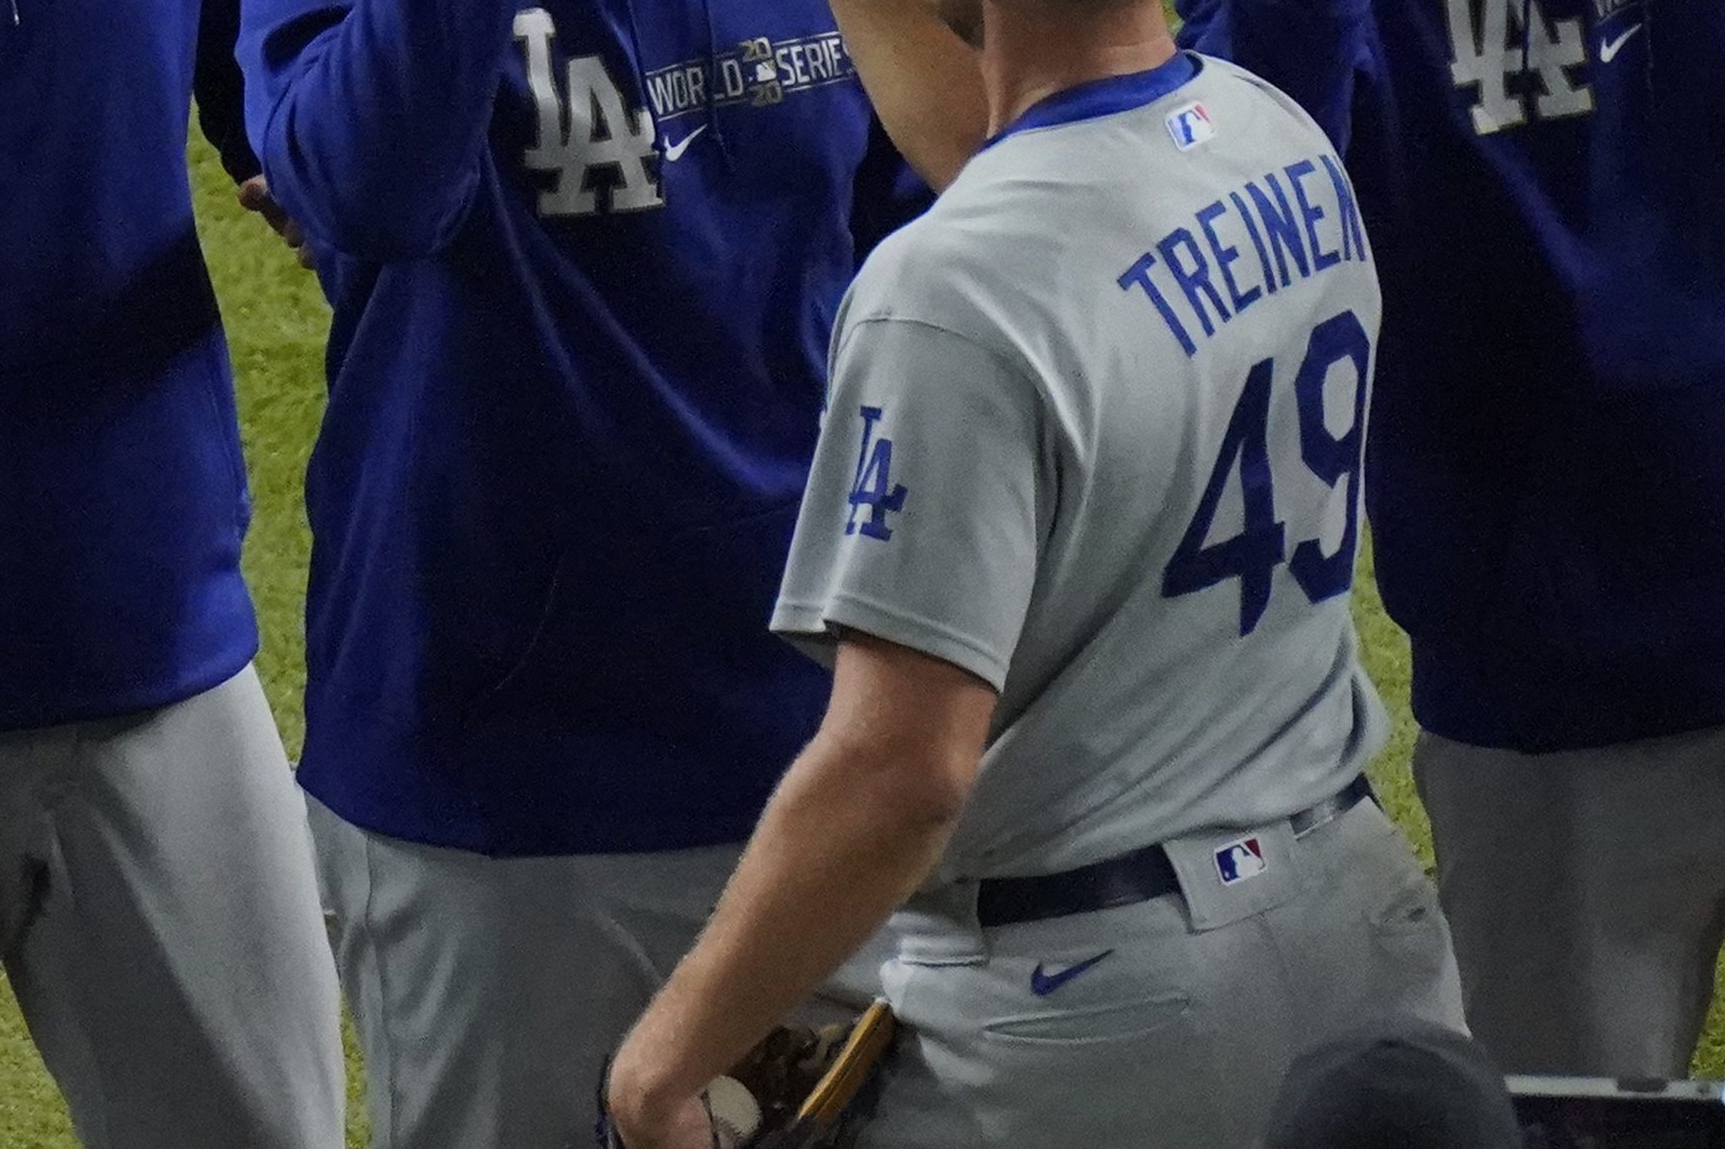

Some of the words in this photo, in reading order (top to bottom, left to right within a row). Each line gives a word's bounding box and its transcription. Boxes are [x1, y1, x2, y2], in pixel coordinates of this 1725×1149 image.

[512, 5, 664, 215] LA
[740, 37, 773, 63] 20
[1117, 154, 1366, 358] TREINEN
[845, 405, 908, 542] LA
[1161, 308, 1371, 638] 49
